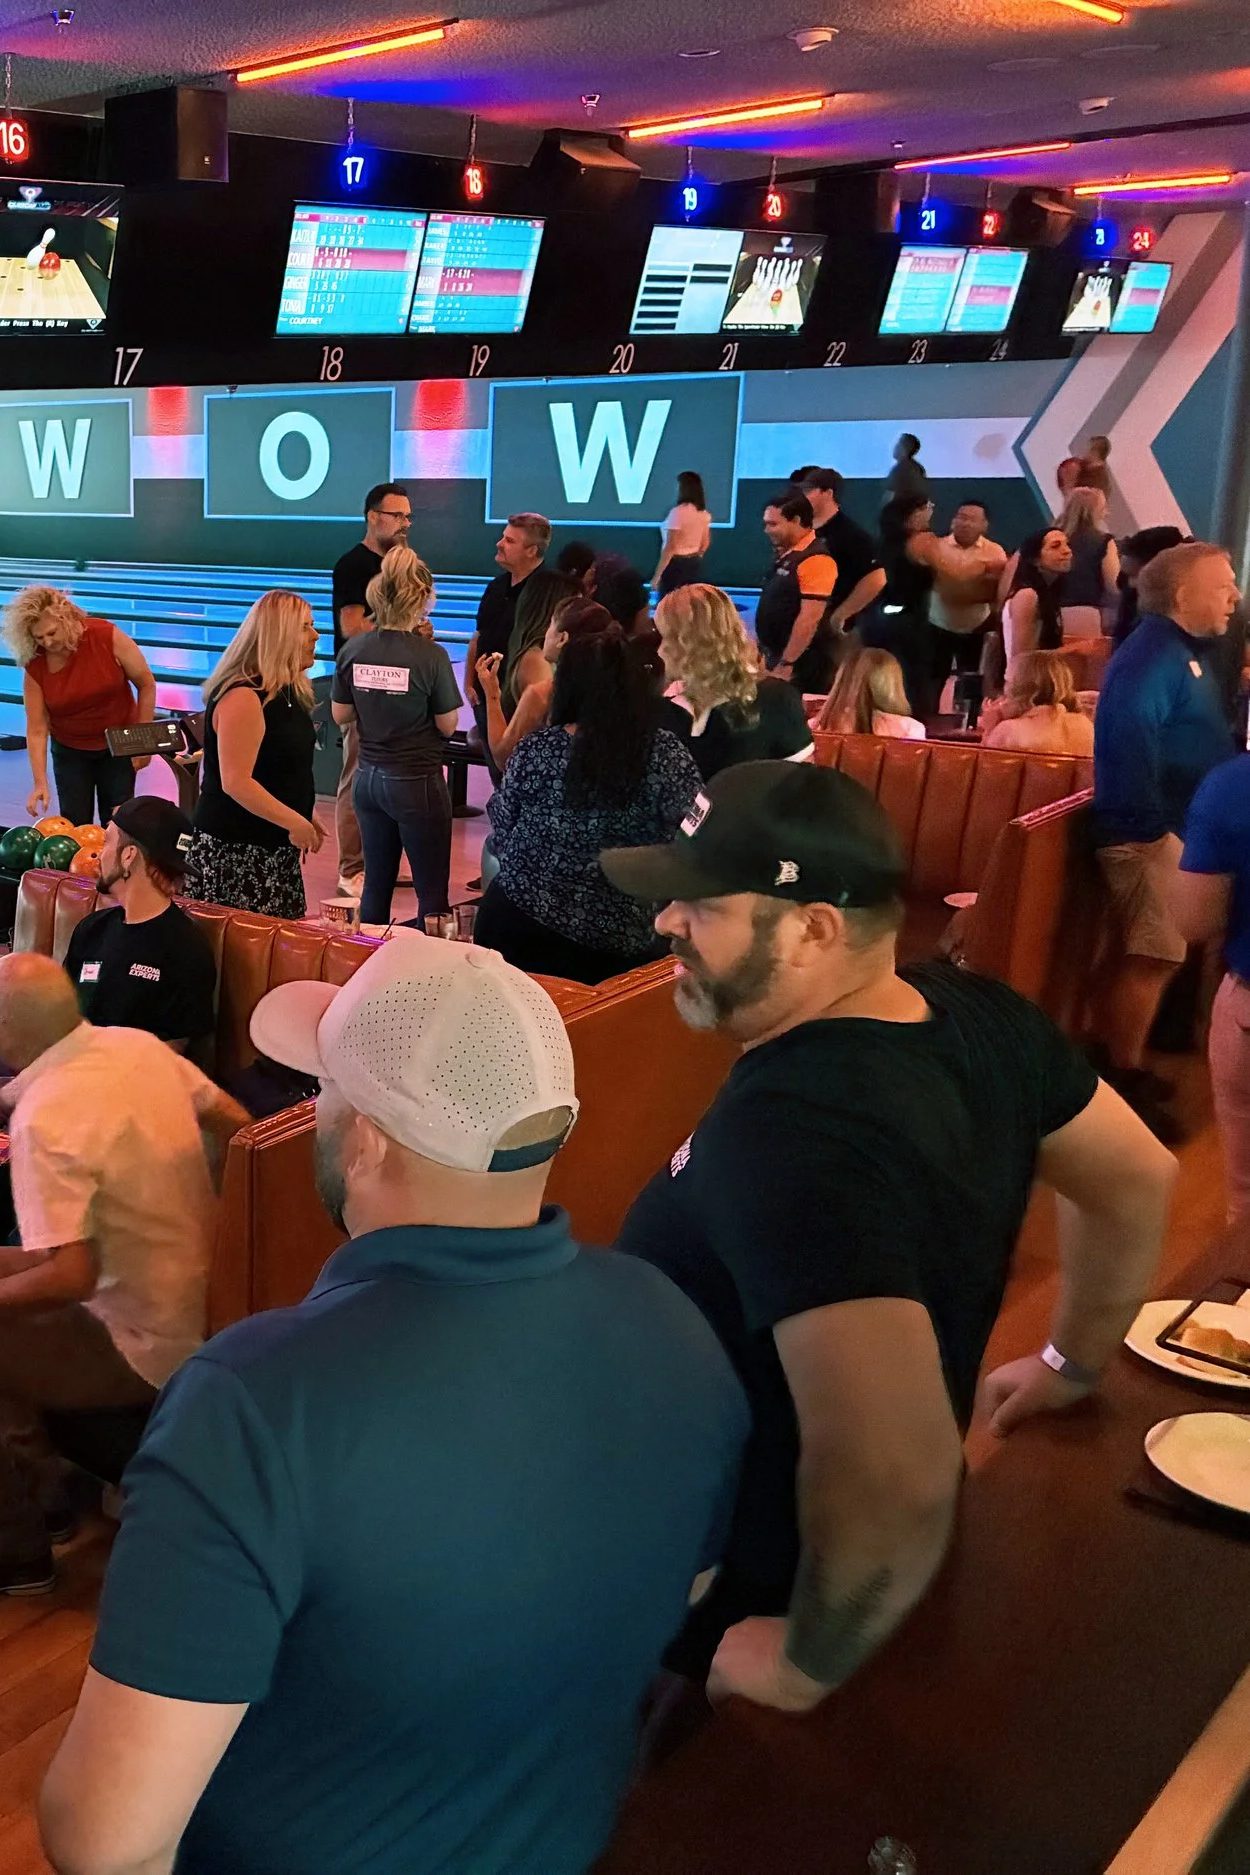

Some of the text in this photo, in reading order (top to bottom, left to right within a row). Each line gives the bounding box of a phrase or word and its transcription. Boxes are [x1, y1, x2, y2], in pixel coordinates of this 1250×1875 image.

[343, 156, 365, 184] 17
[465, 168, 483, 195] 18
[682, 187, 698, 211] 19
[768, 193, 782, 218] 20
[921, 209, 936, 231] 21
[983, 215, 995, 235] 22
[1132, 231, 1150, 251] 24
[56, 320, 69, 328] Key
[468, 344, 490, 377] 19
[608, 343, 635, 374] 20
[718, 342, 739, 370] 21
[823, 341, 847, 367] 22
[907, 339, 929, 364] 23
[988, 338, 1009, 361] 24
[113, 346, 144, 386] 17
[319, 345, 344, 381] 18
[17, 399, 673, 505] W O W
[360, 669, 402, 679] CLAYTON
[129, 969, 160, 982] EXPERTS
[130, 963, 161, 976] ARIZONA
